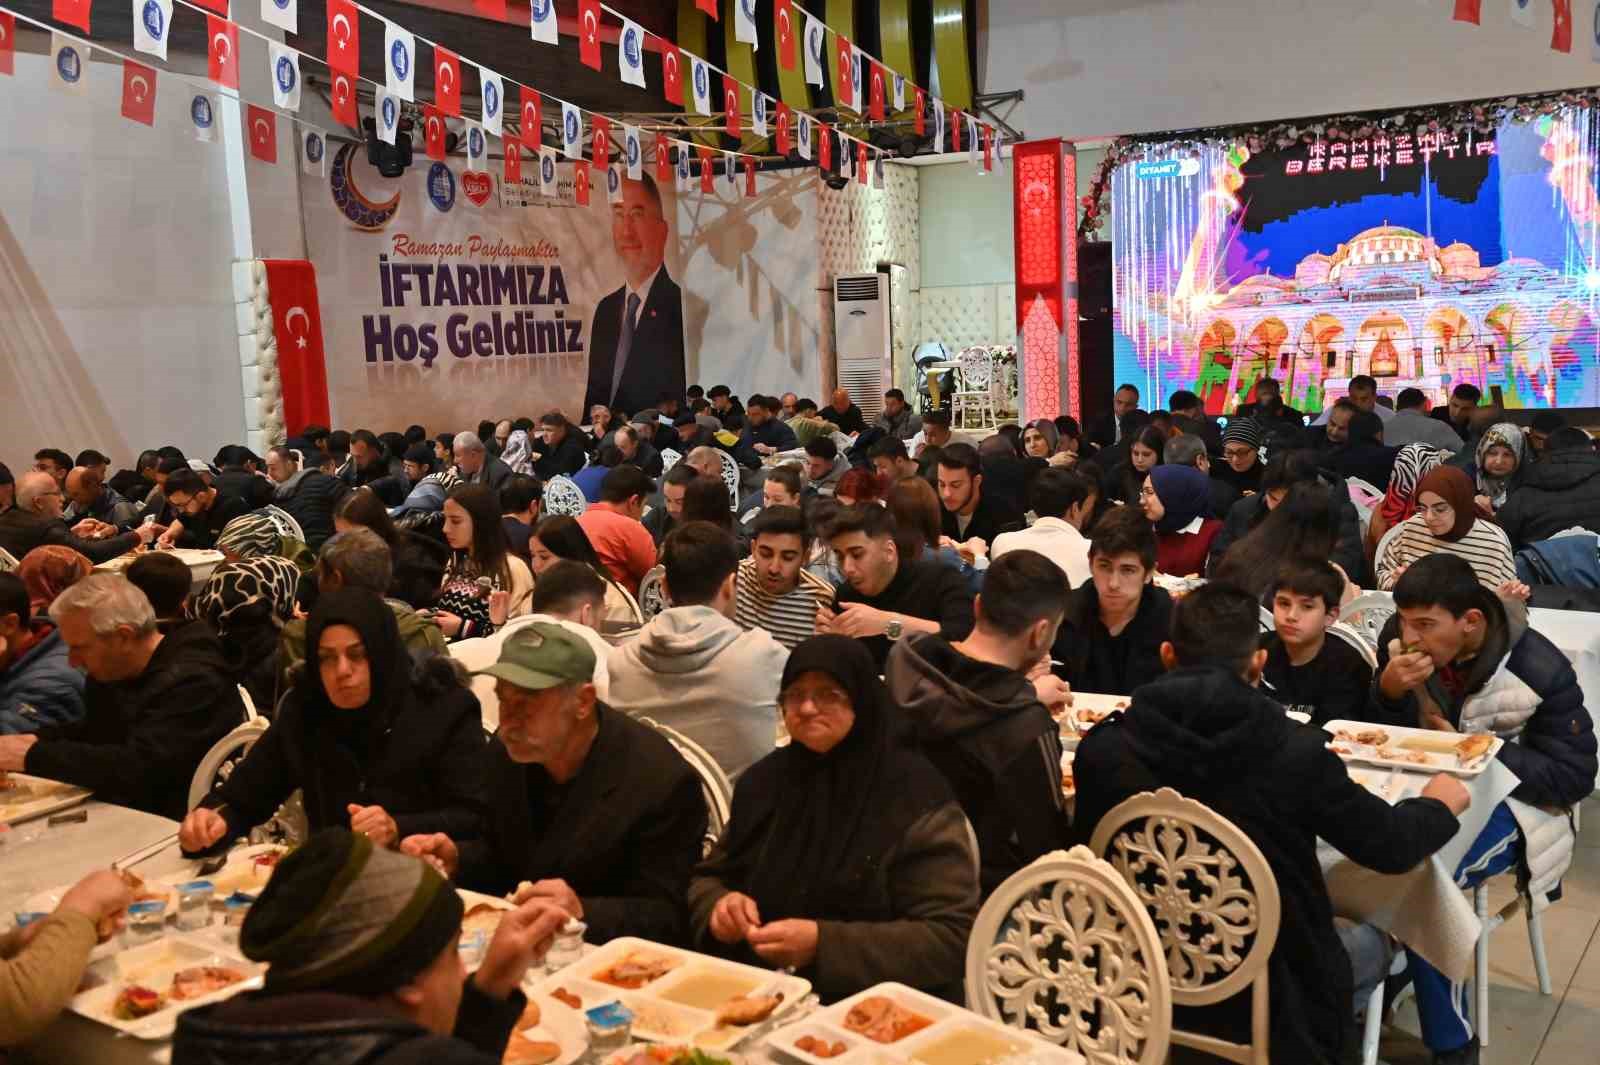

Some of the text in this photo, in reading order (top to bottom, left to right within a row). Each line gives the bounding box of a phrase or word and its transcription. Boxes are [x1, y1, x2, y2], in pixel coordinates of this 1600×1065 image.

[391, 233, 560, 263] Ramazan Paylaşmaktır
[379, 254, 569, 307] İFTARIMIZA
[362, 310, 584, 368] Hoş Geldiniz
